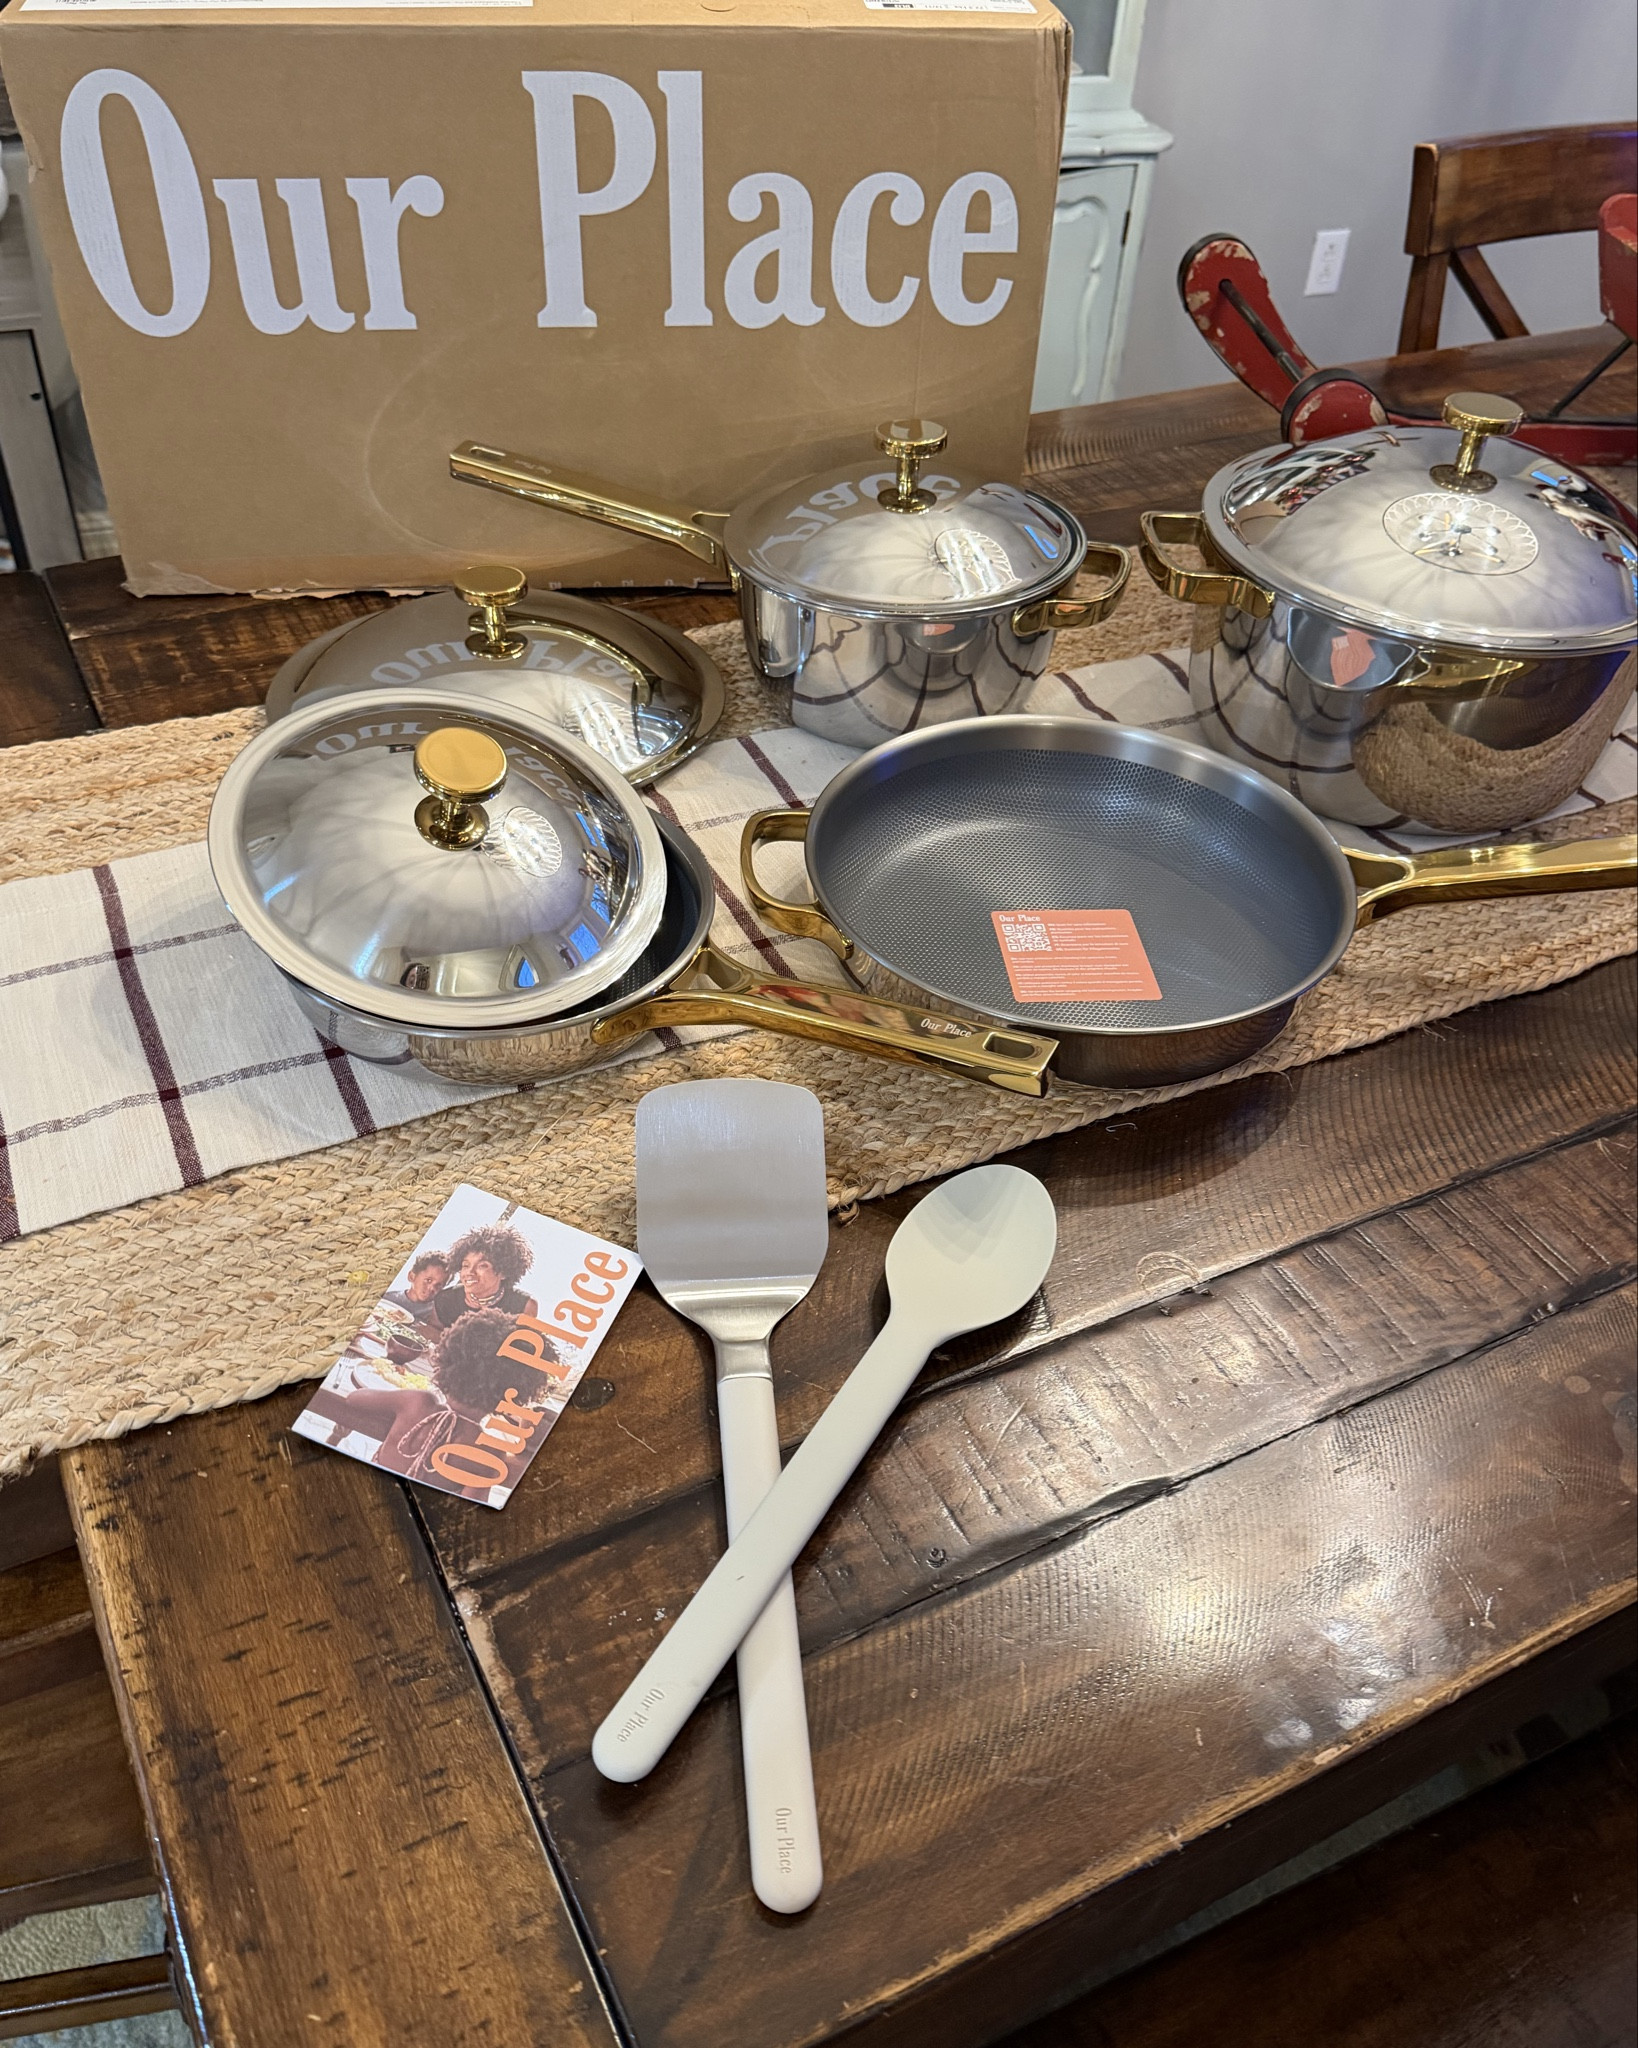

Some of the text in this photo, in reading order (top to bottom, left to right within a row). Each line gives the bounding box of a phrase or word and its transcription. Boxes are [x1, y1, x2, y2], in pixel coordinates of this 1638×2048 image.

[60, 68, 1020, 338] Our Place
[999, 914, 1041, 923] Our Place
[920, 1017, 973, 1039] Our Place
[430, 1250, 629, 1489] Our Place
[617, 1688, 665, 1743] Our Place
[775, 1807, 796, 1874] Our Place
